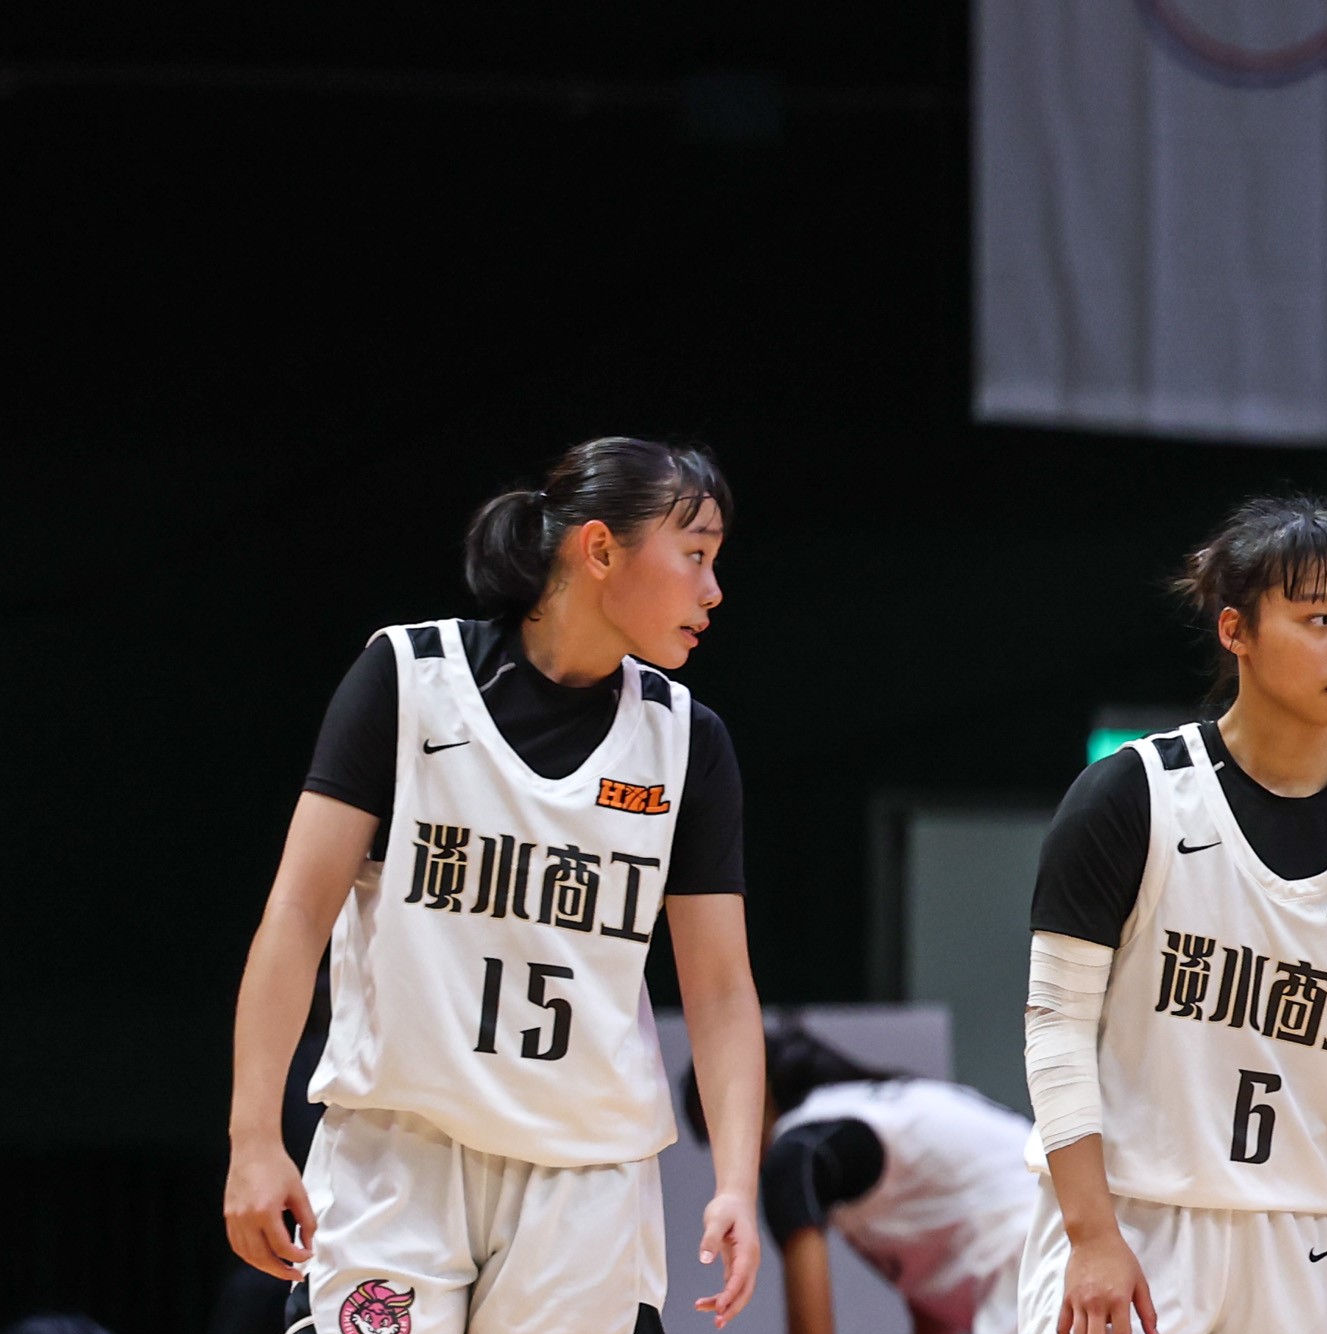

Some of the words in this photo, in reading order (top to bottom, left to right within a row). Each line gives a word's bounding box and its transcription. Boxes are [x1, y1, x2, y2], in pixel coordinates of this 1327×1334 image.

[596, 778, 670, 816] HBL
[404, 820, 661, 944] 淡水商工
[473, 957, 575, 1061] 15
[1230, 1068, 1282, 1165] 6
